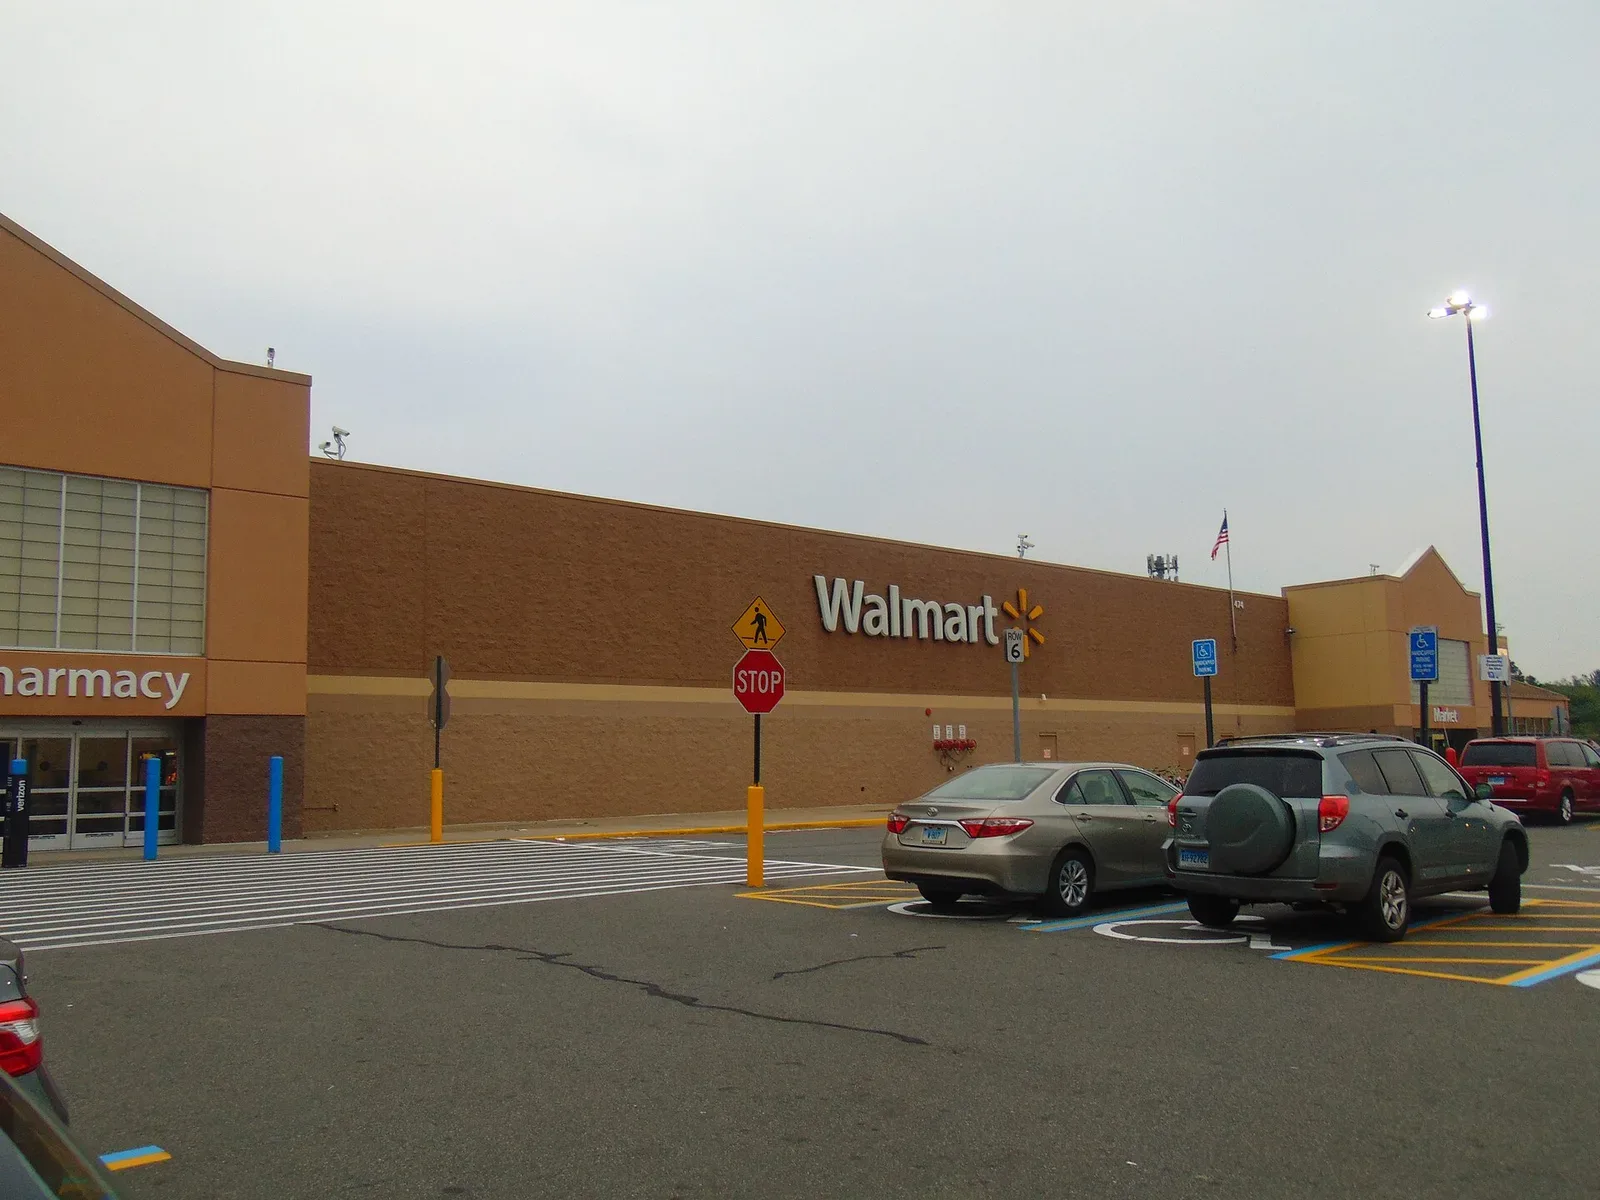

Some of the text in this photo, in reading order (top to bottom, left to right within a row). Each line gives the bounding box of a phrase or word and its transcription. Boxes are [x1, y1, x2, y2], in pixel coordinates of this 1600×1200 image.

[813, 575, 999, 645] Walmart
[1007, 632, 1022, 641] ROW
[1011, 643, 1021, 659] 6
[737, 670, 782, 694] STOP
[16, 780, 26, 812] verizon
